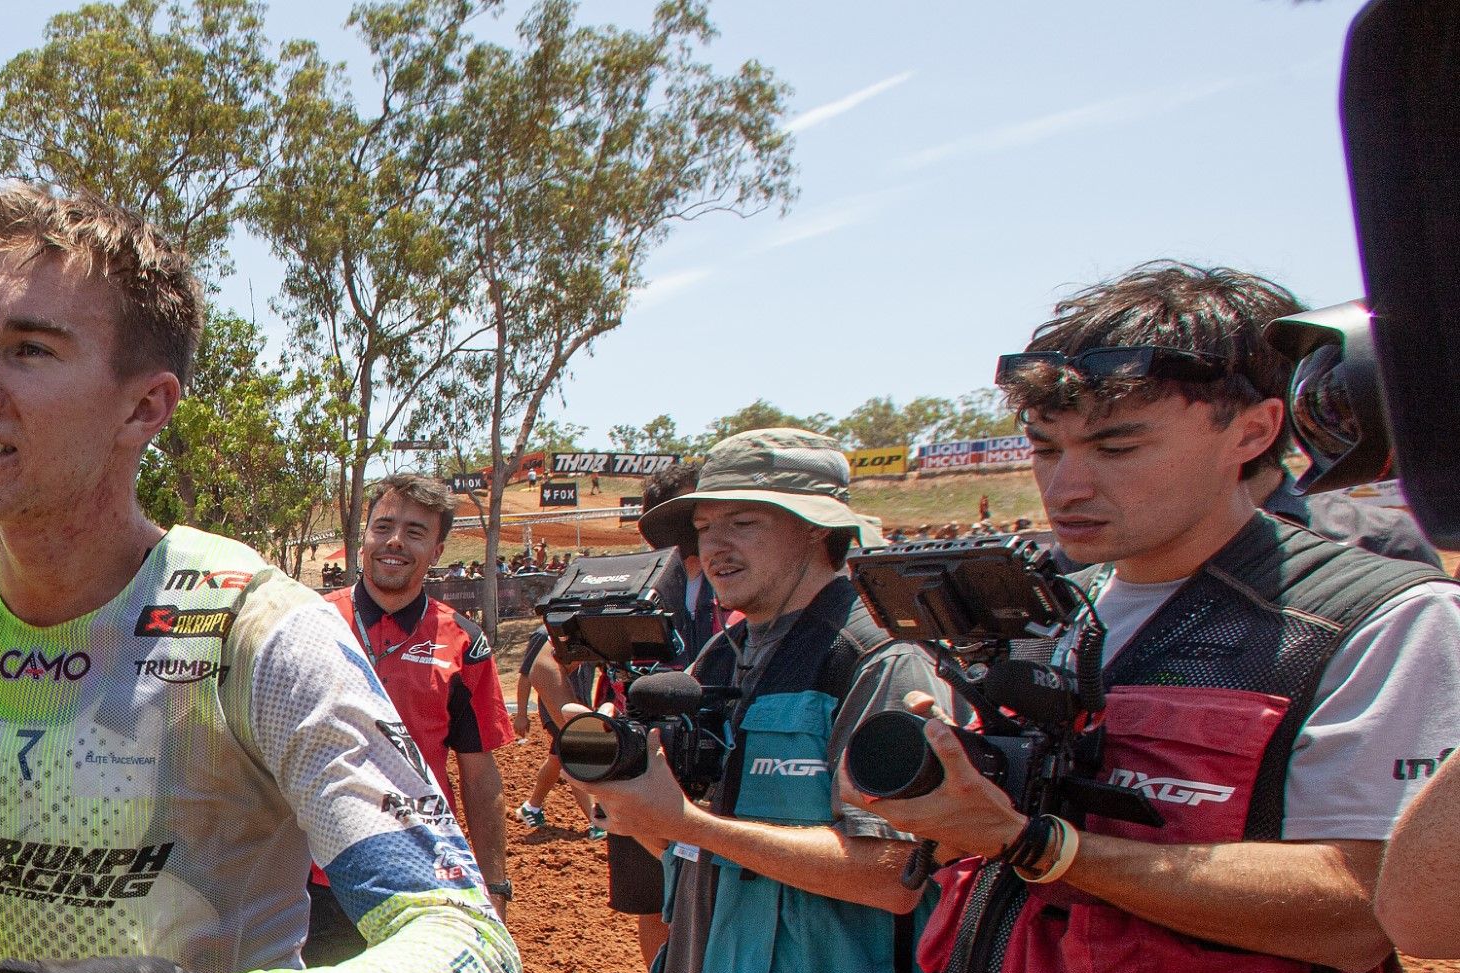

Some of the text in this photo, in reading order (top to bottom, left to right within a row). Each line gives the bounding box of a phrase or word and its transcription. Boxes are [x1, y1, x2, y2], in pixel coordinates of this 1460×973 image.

[554, 454, 608, 472] THOR
[552, 489, 575, 500] FOX
[85, 754, 157, 766] ELITE RACEWEAR
[749, 758, 830, 777] MXGP
[60, 896, 116, 910] TEAM
